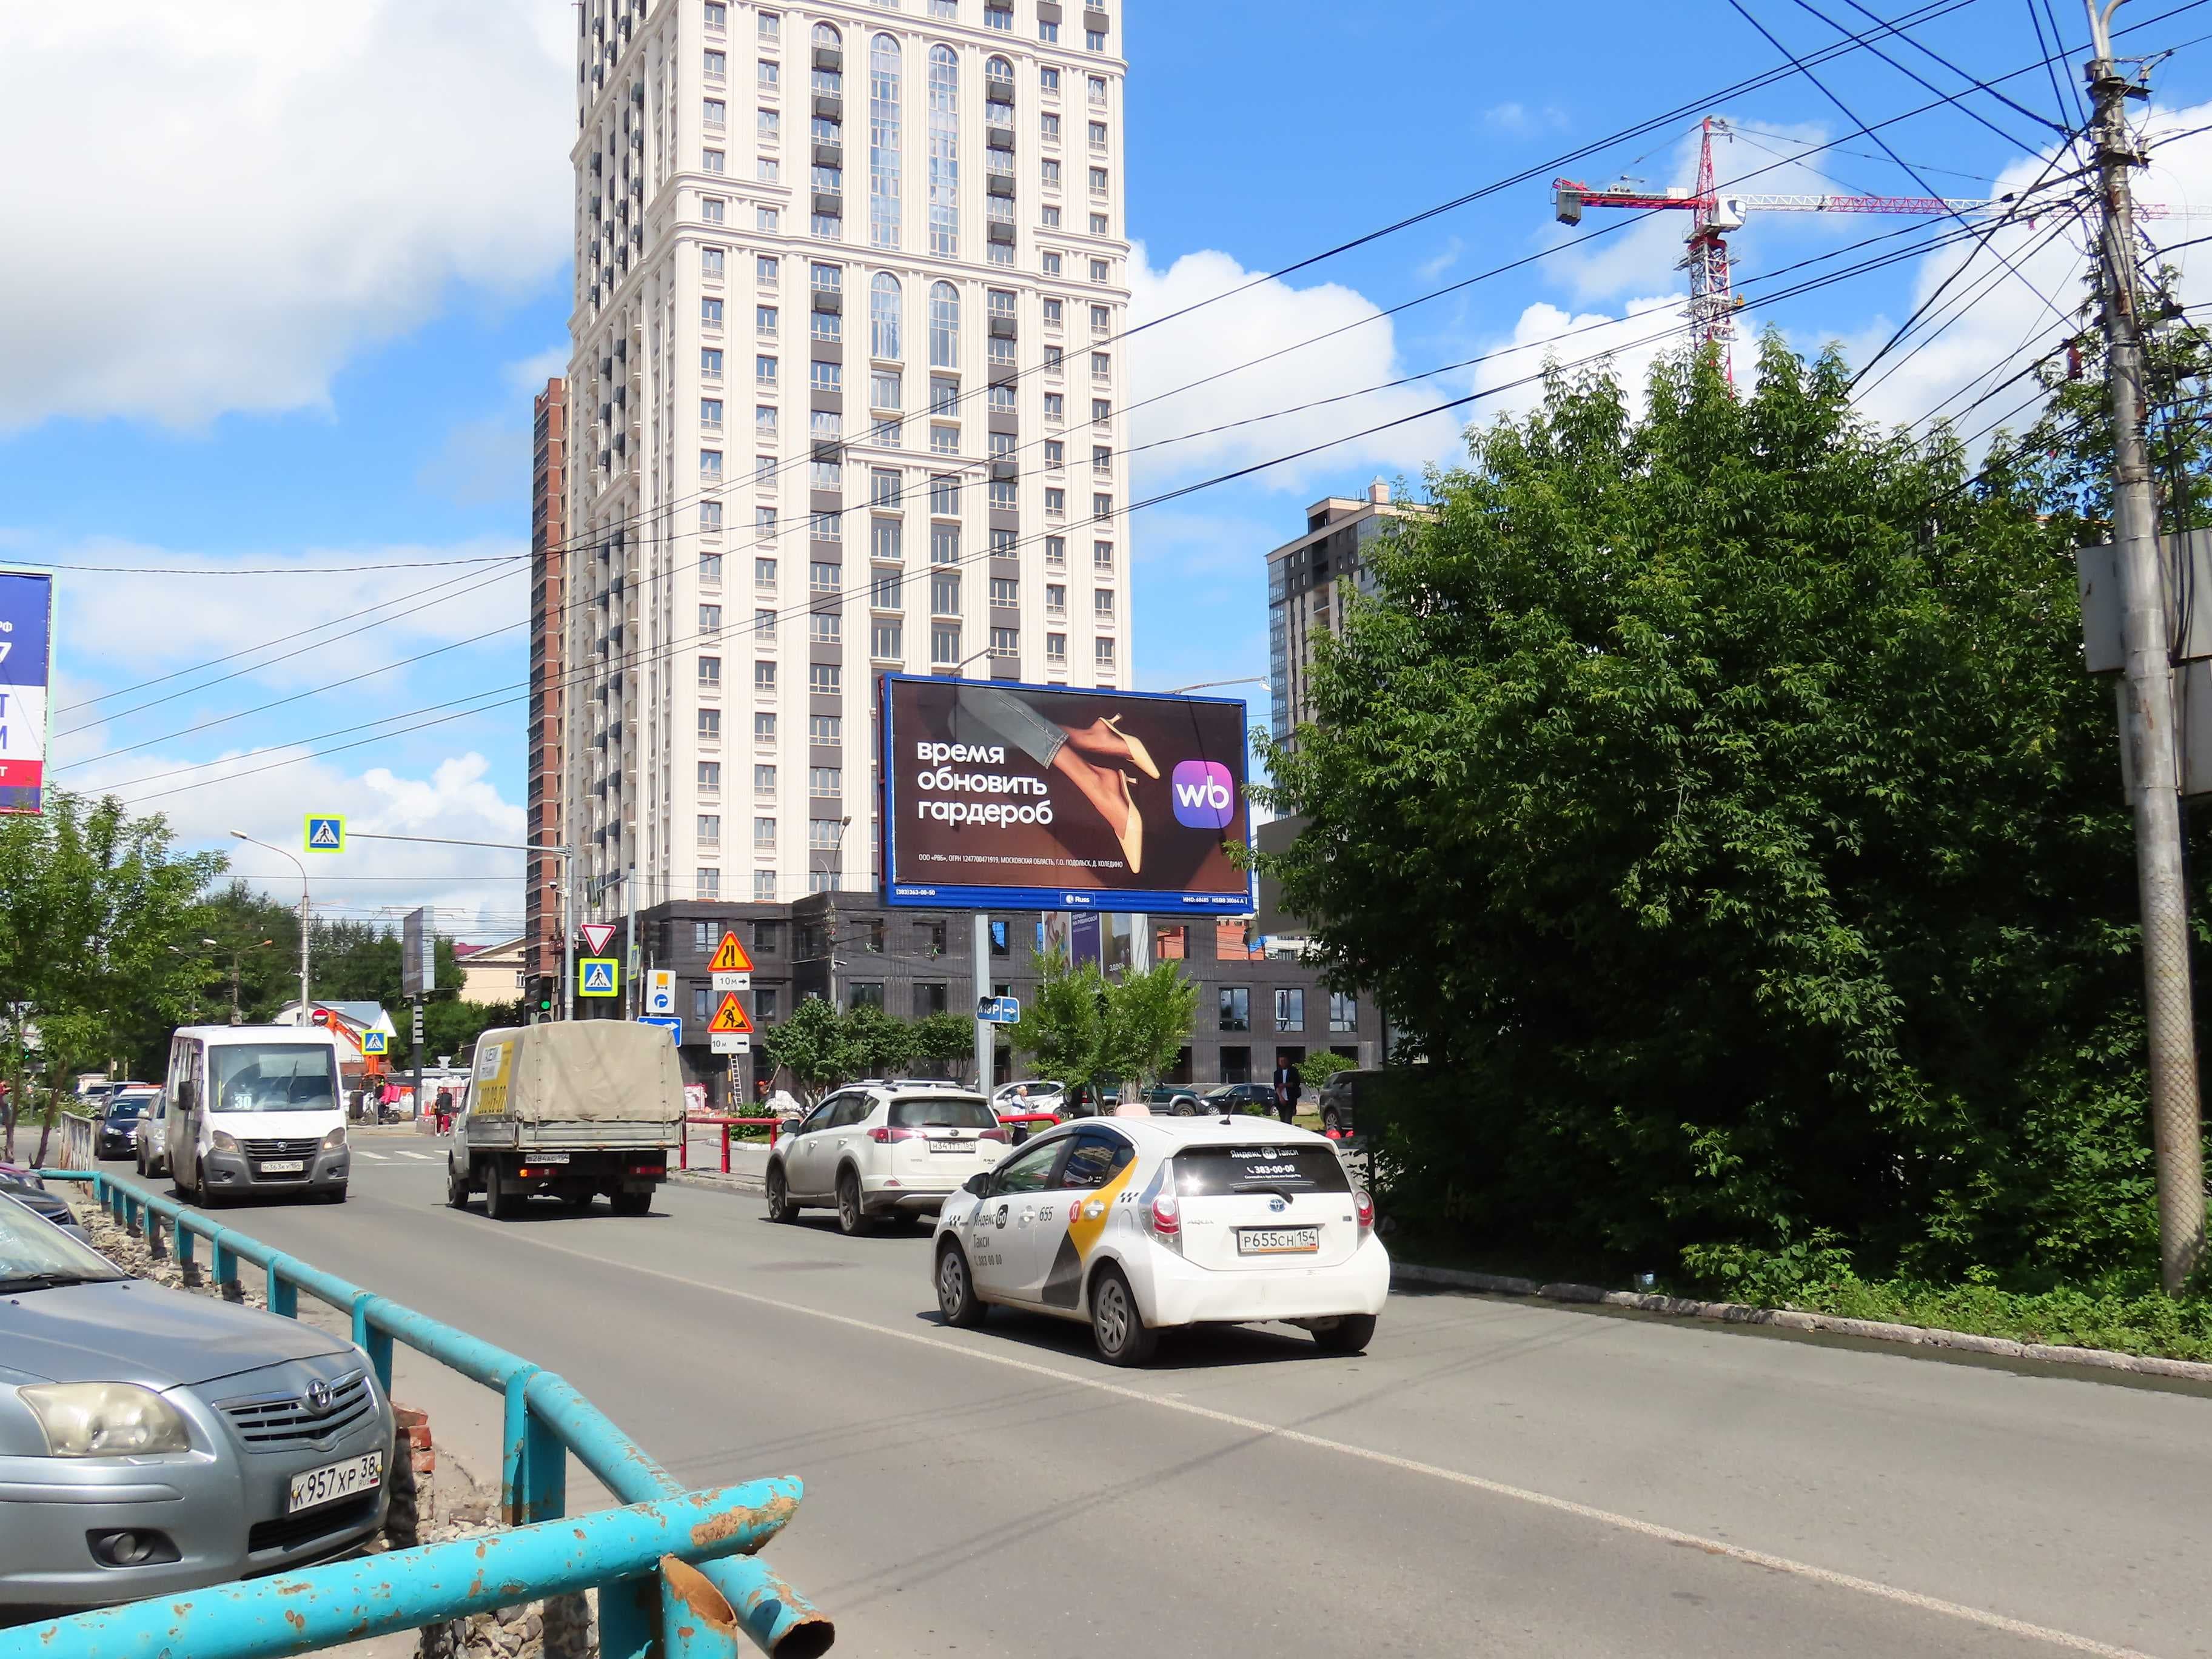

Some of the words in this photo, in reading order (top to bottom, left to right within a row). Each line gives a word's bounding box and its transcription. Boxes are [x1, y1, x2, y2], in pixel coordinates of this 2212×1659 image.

[917, 742, 1004, 766] время
[917, 766, 1047, 795] обновить
[1176, 776, 1229, 809] wb
[918, 800, 1053, 828] гардероб
[235, 1096, 252, 1109] 30
[1230, 1150, 1262, 1159] Яндекс
[1254, 1164, 1295, 1174] 383-00-00
[974, 1213, 995, 1227] Яндекс
[1039, 1206, 1053, 1221] 655
[973, 1234, 990, 1248] Такси
[1244, 1233, 1293, 1247] Р655СН
[1297, 1231, 1315, 1242] 154
[294, 1468, 356, 1507] К957ХР
[361, 1456, 375, 1478] 38
